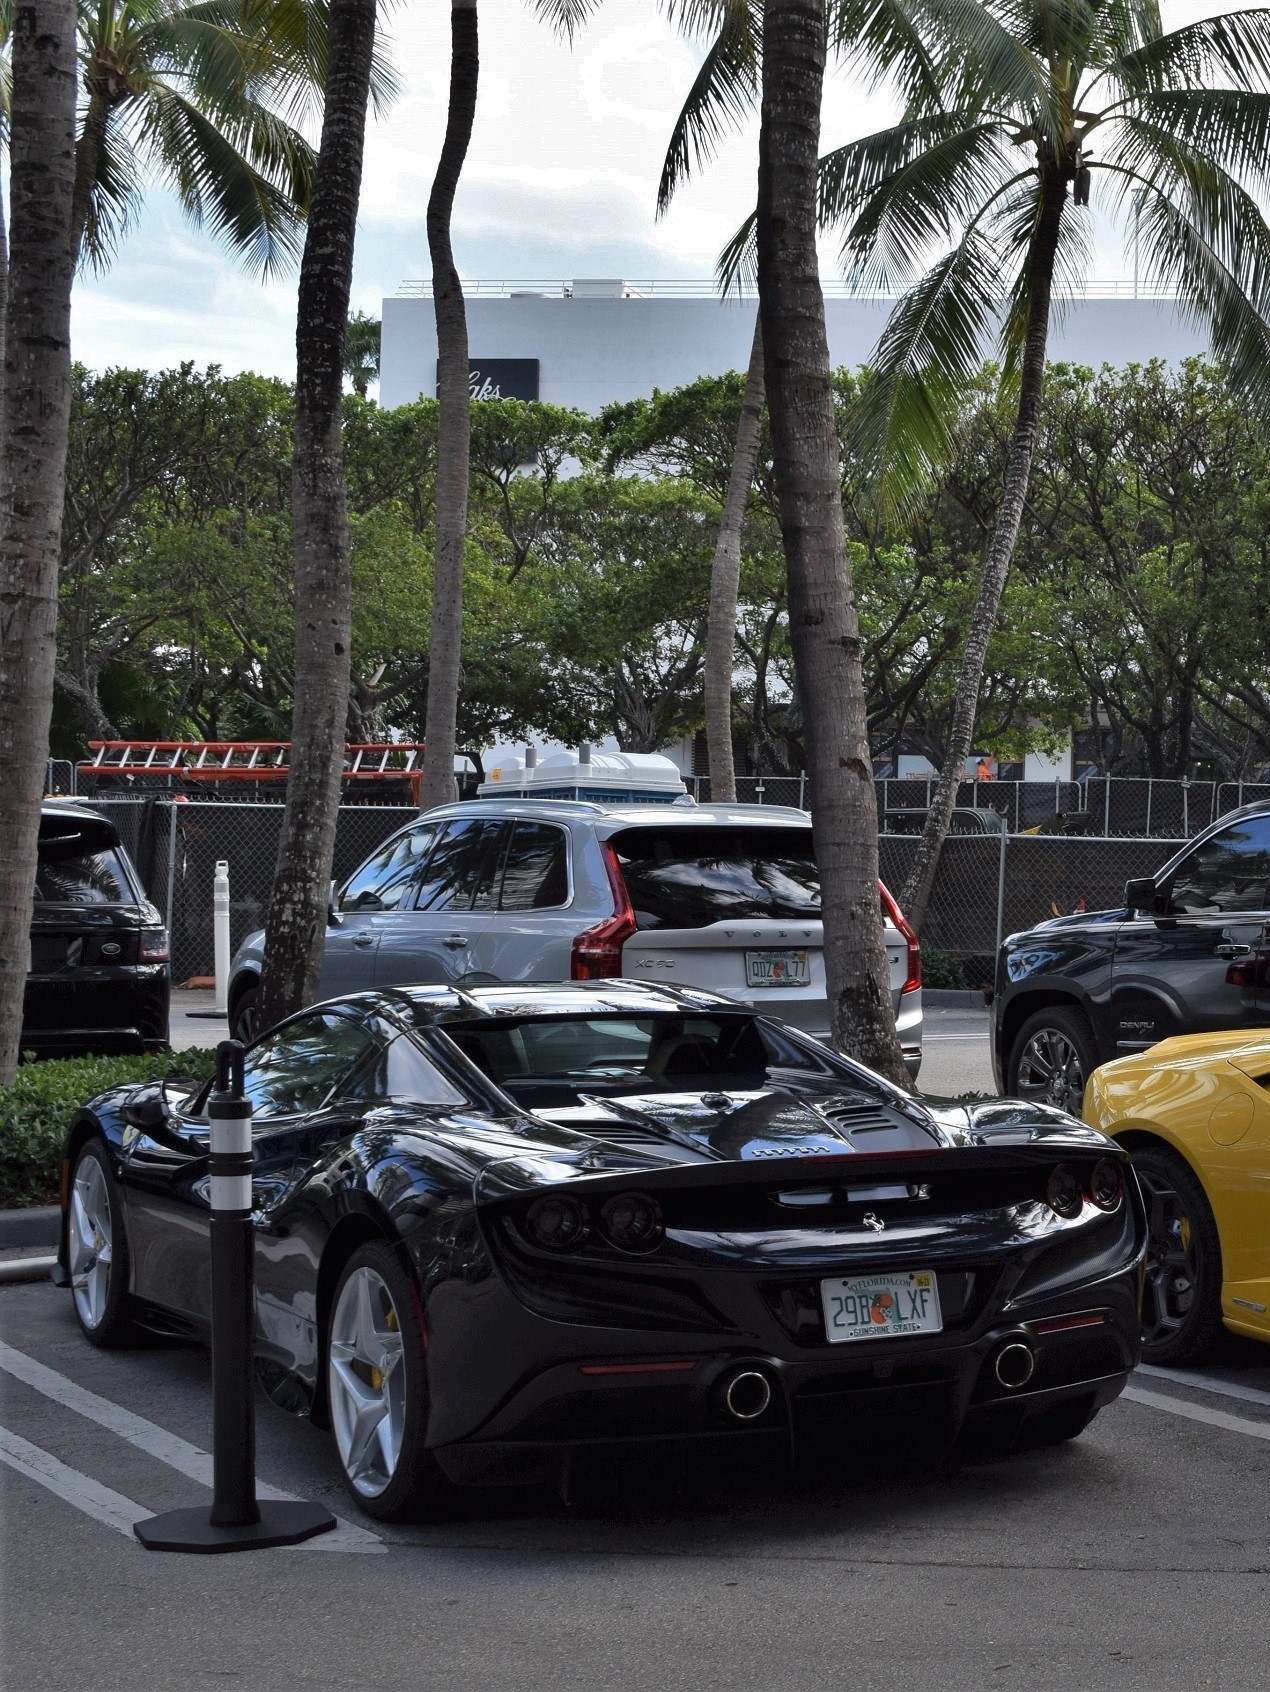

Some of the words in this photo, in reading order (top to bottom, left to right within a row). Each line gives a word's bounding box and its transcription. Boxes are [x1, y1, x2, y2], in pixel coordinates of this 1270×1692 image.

[724, 930, 814, 938] VOLV
[1119, 1021, 1155, 1029] DENALI
[853, 1324, 890, 1337] SUNSHINE
[893, 1322, 916, 1334] STATE
